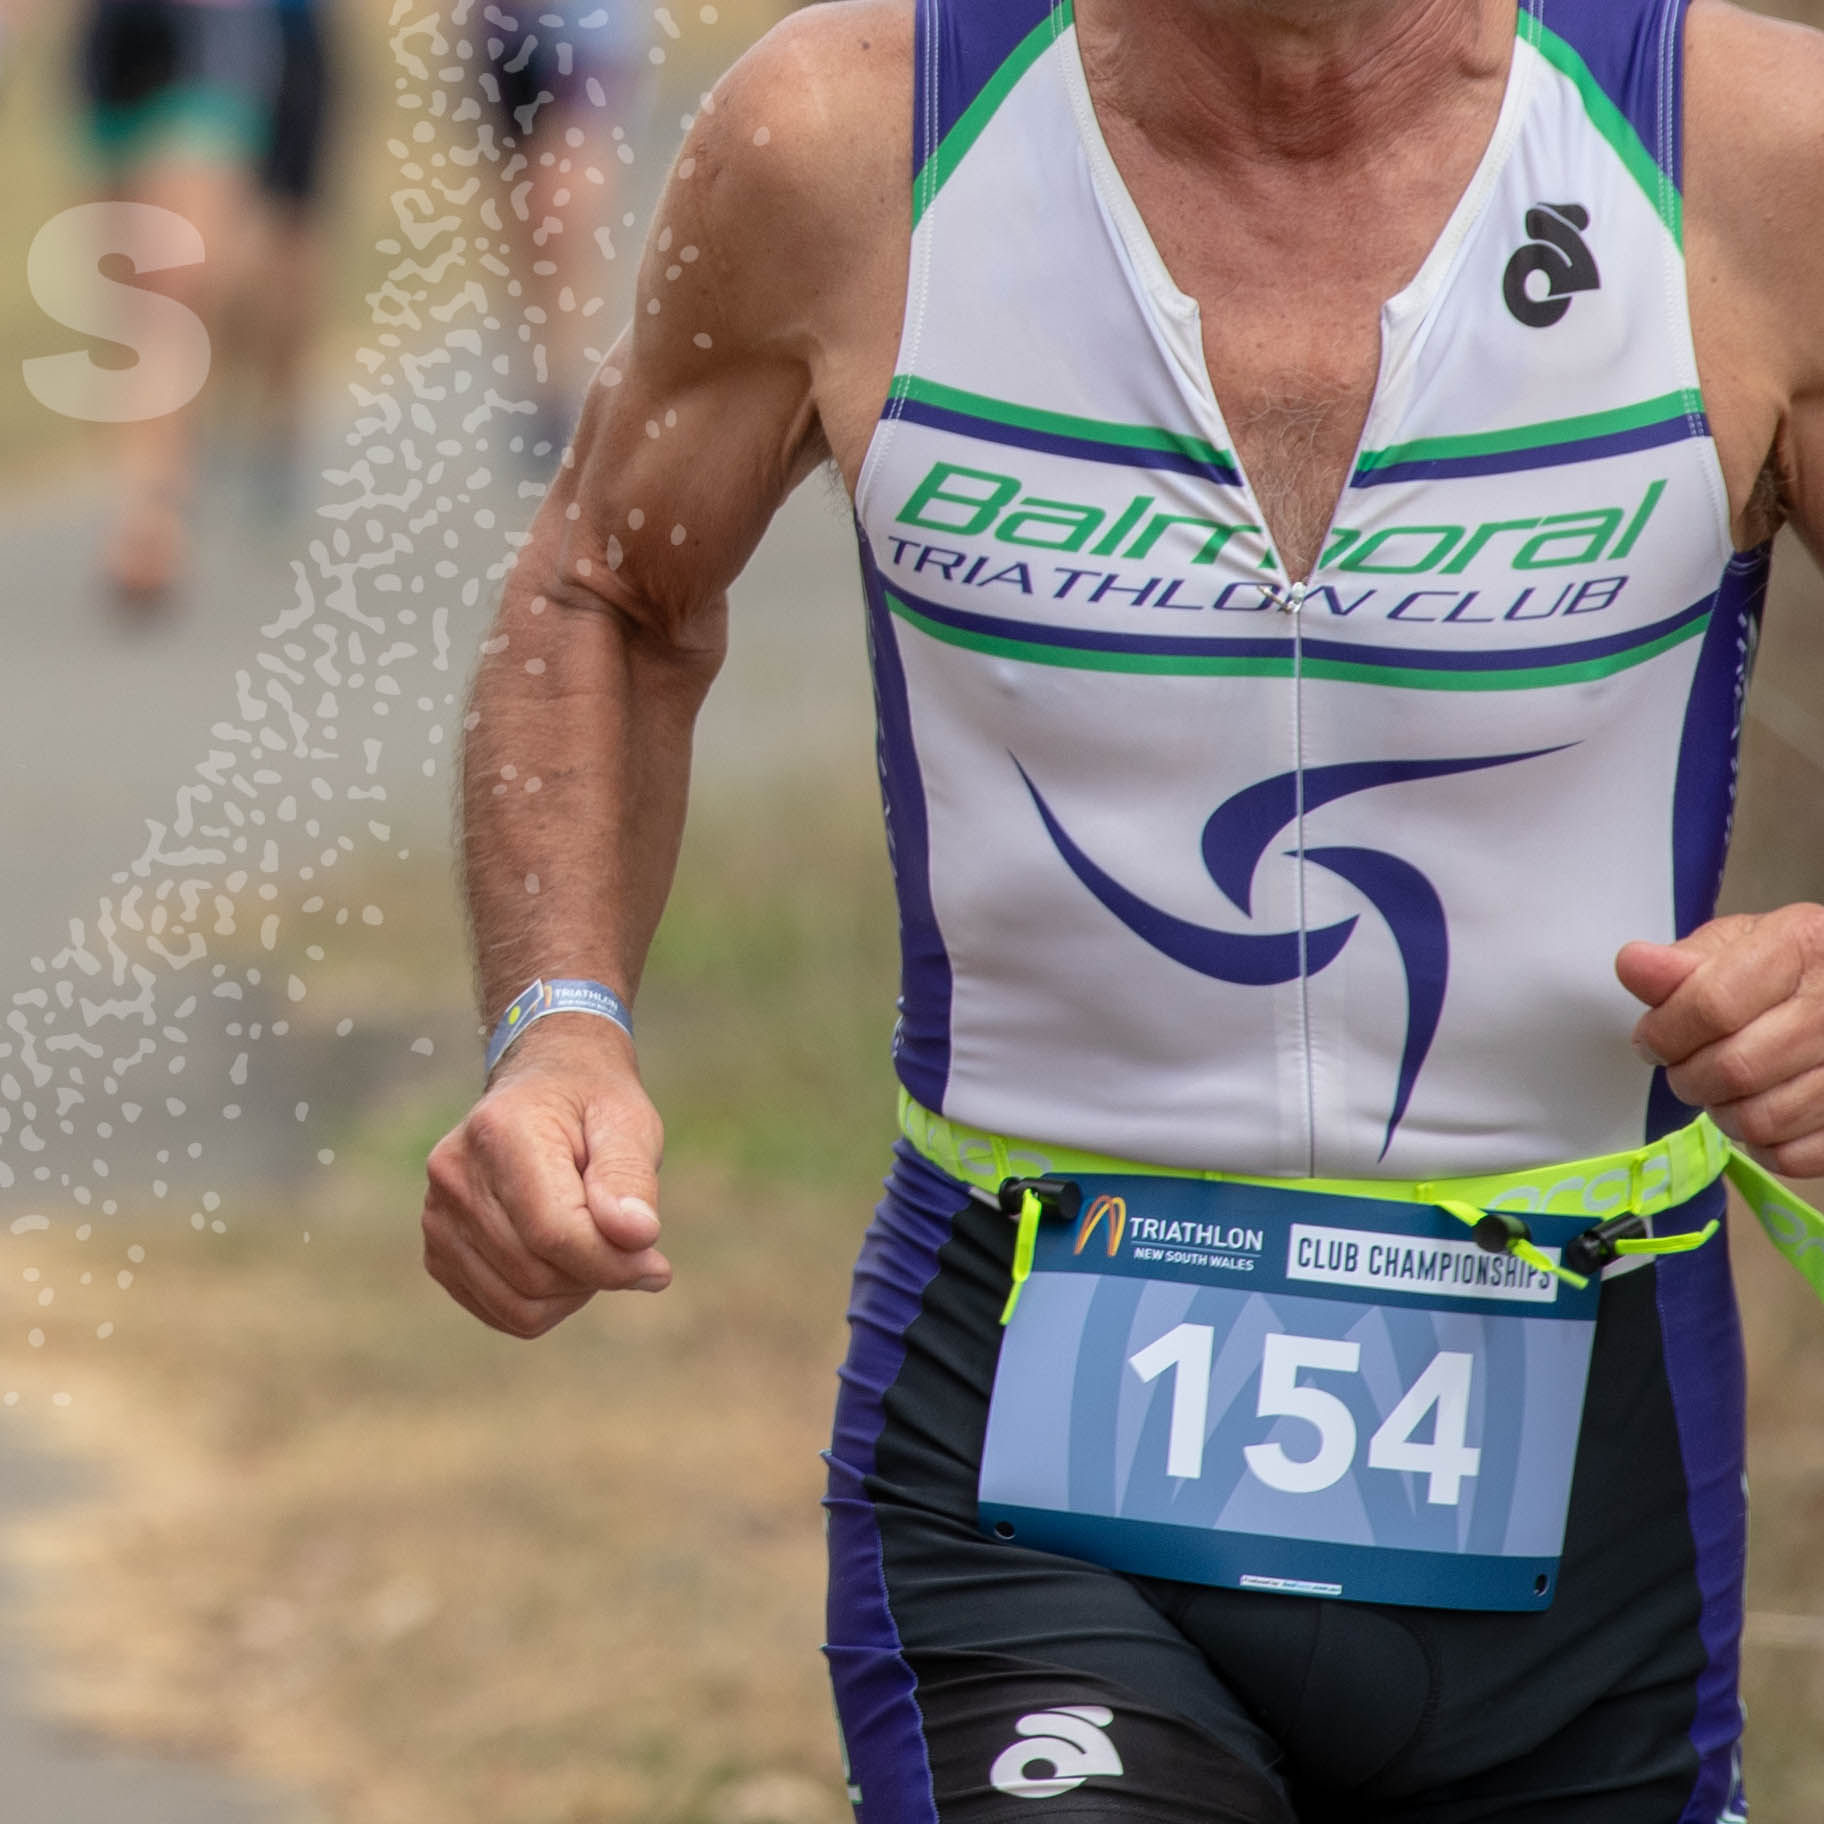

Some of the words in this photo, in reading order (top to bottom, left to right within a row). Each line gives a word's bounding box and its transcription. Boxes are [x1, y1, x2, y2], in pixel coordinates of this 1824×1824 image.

[895, 461, 1668, 575] Balmoral
[888, 536, 1376, 617] TRIATHLON
[1386, 576, 1629, 624] CLUB
[1129, 1217, 1264, 1251] TRIATHLON
[1297, 1237, 1359, 1273] CLUB
[1369, 1245, 1551, 1289] CHAMPIONSHIPS
[1134, 1247, 1164, 1261] NEW
[1165, 1250, 1208, 1267] SOUTH
[1209, 1255, 1255, 1272] WALES
[1129, 1323, 1480, 1506] 154
